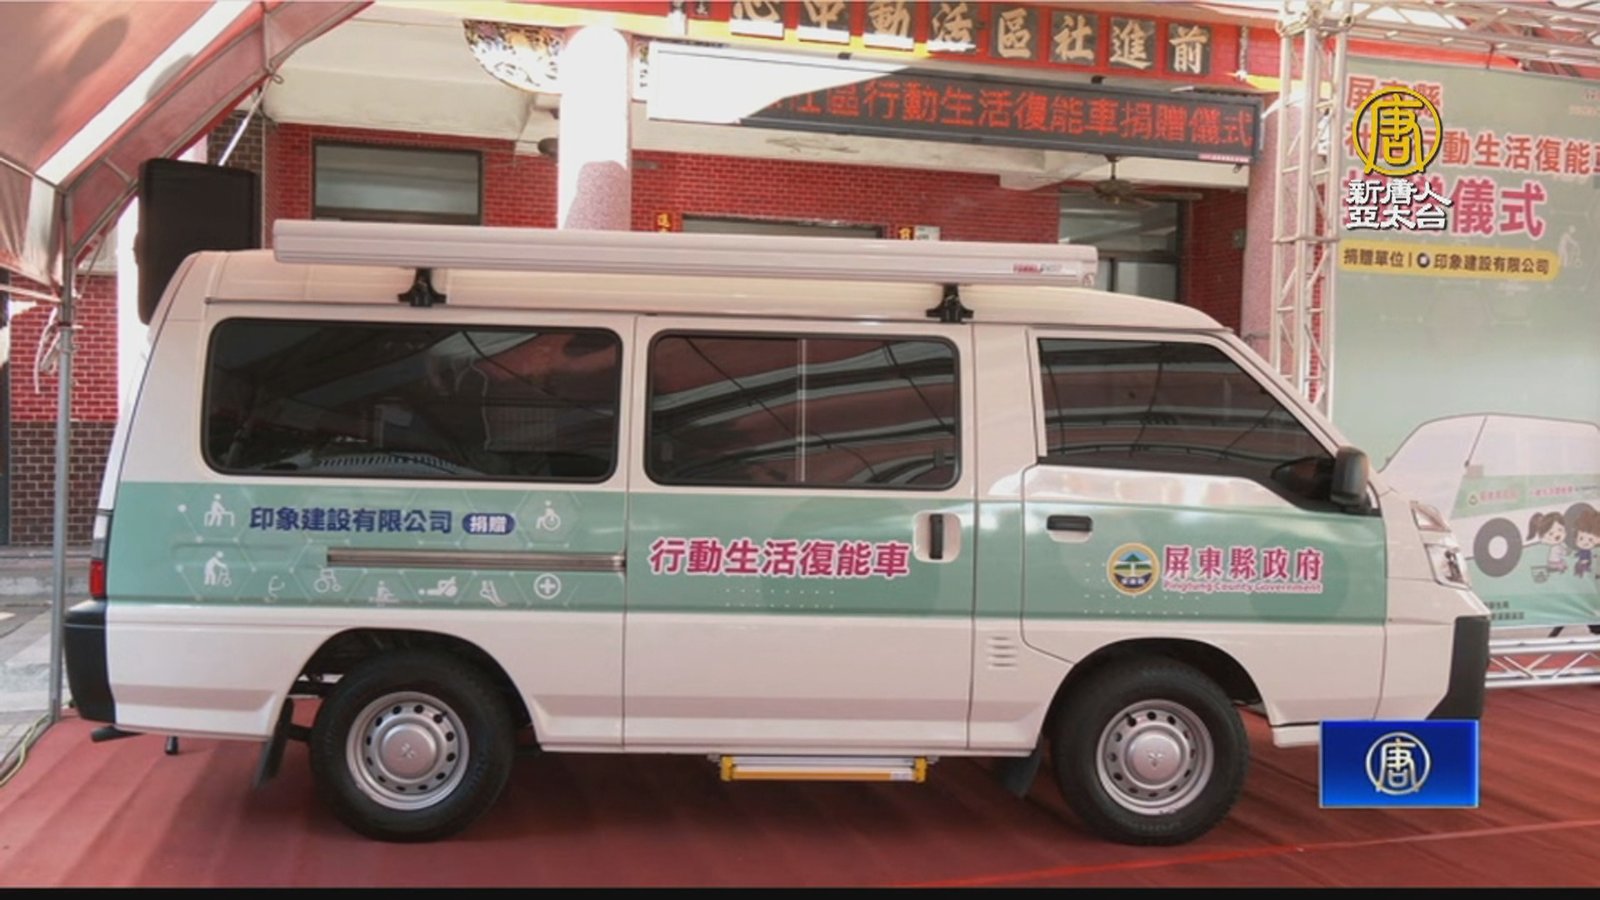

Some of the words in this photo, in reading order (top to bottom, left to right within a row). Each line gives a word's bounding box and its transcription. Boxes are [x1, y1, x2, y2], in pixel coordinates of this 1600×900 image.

[772, 78, 1254, 147] 區行動生活復能車捐贈儀式
[1346, 75, 1442, 119] 屏縣
[1345, 122, 1600, 175] 社動生活復能
[1344, 170, 1546, 238] 儀式
[1344, 248, 1404, 268] 捐贈單位
[1433, 253, 1550, 275] 印象建設有限公司
[249, 506, 453, 534] 印象建設有限公司
[469, 515, 508, 533] 捐贈
[650, 539, 910, 577] 行動生活復能車
[1164, 546, 1322, 582] 屏東縣政府
[1255, 583, 1322, 593] Government
